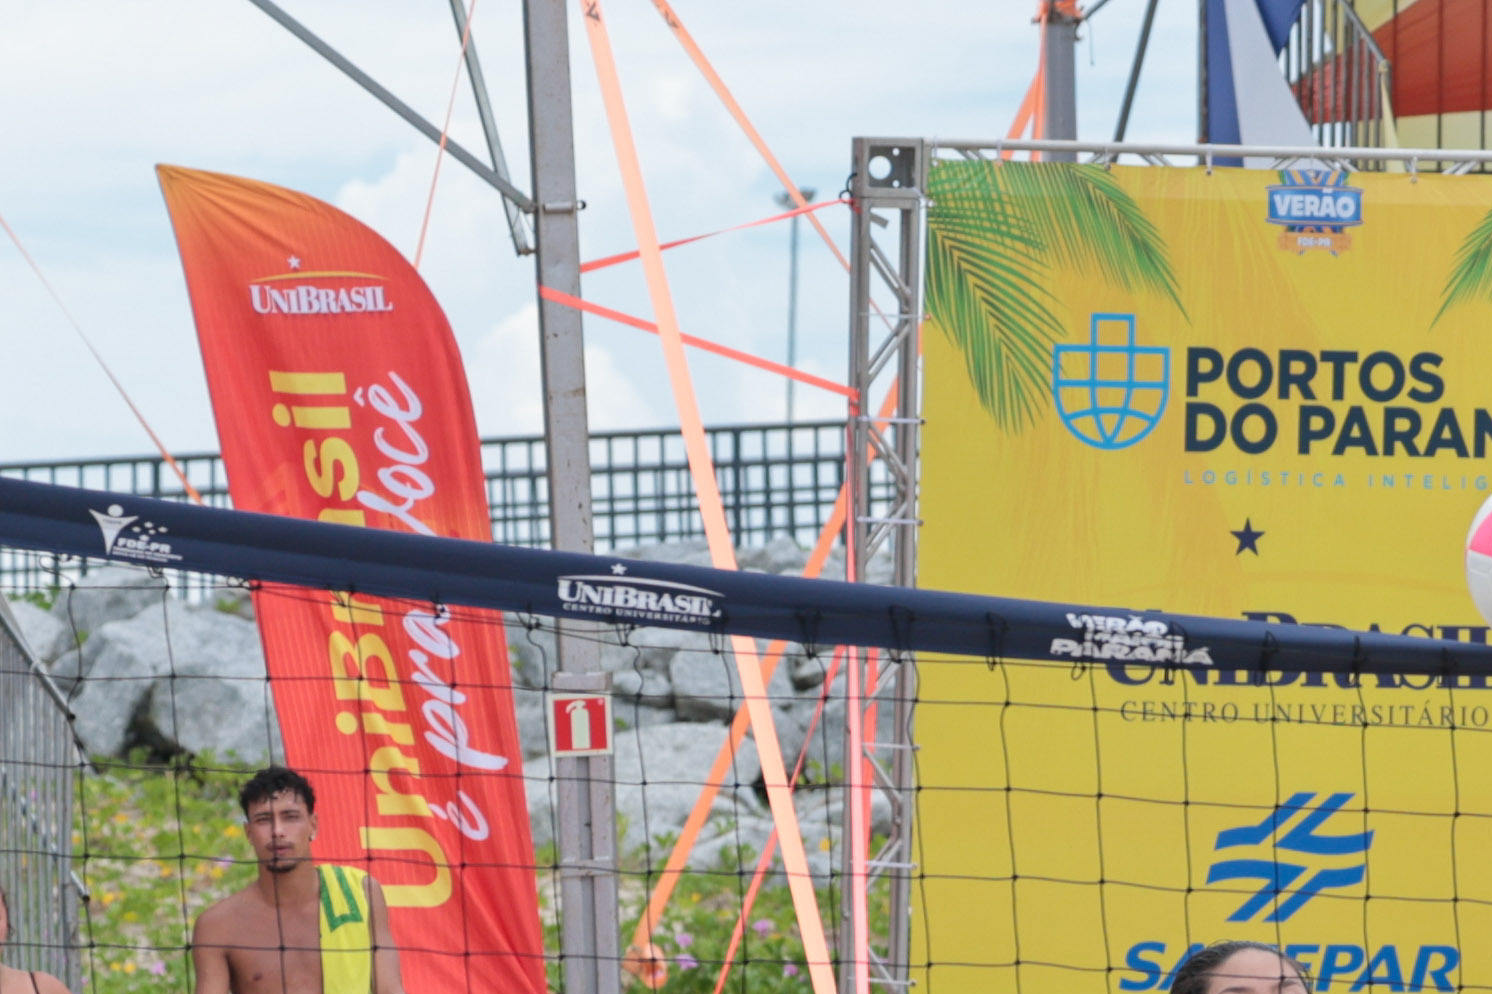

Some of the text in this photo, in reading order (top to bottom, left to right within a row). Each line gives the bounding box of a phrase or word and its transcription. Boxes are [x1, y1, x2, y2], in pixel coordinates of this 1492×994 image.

[1273, 188, 1356, 218] VERÃO
[1186, 346, 1444, 403] PORTOS
[1184, 402, 1278, 455] DO
[1184, 469, 1346, 487] LOGÍSTICA
[563, 603, 612, 615] CENTRO
[1120, 700, 1490, 728] CENTRO UNIVERSITÁRIO
[1119, 941, 1461, 993] SAEPAR
